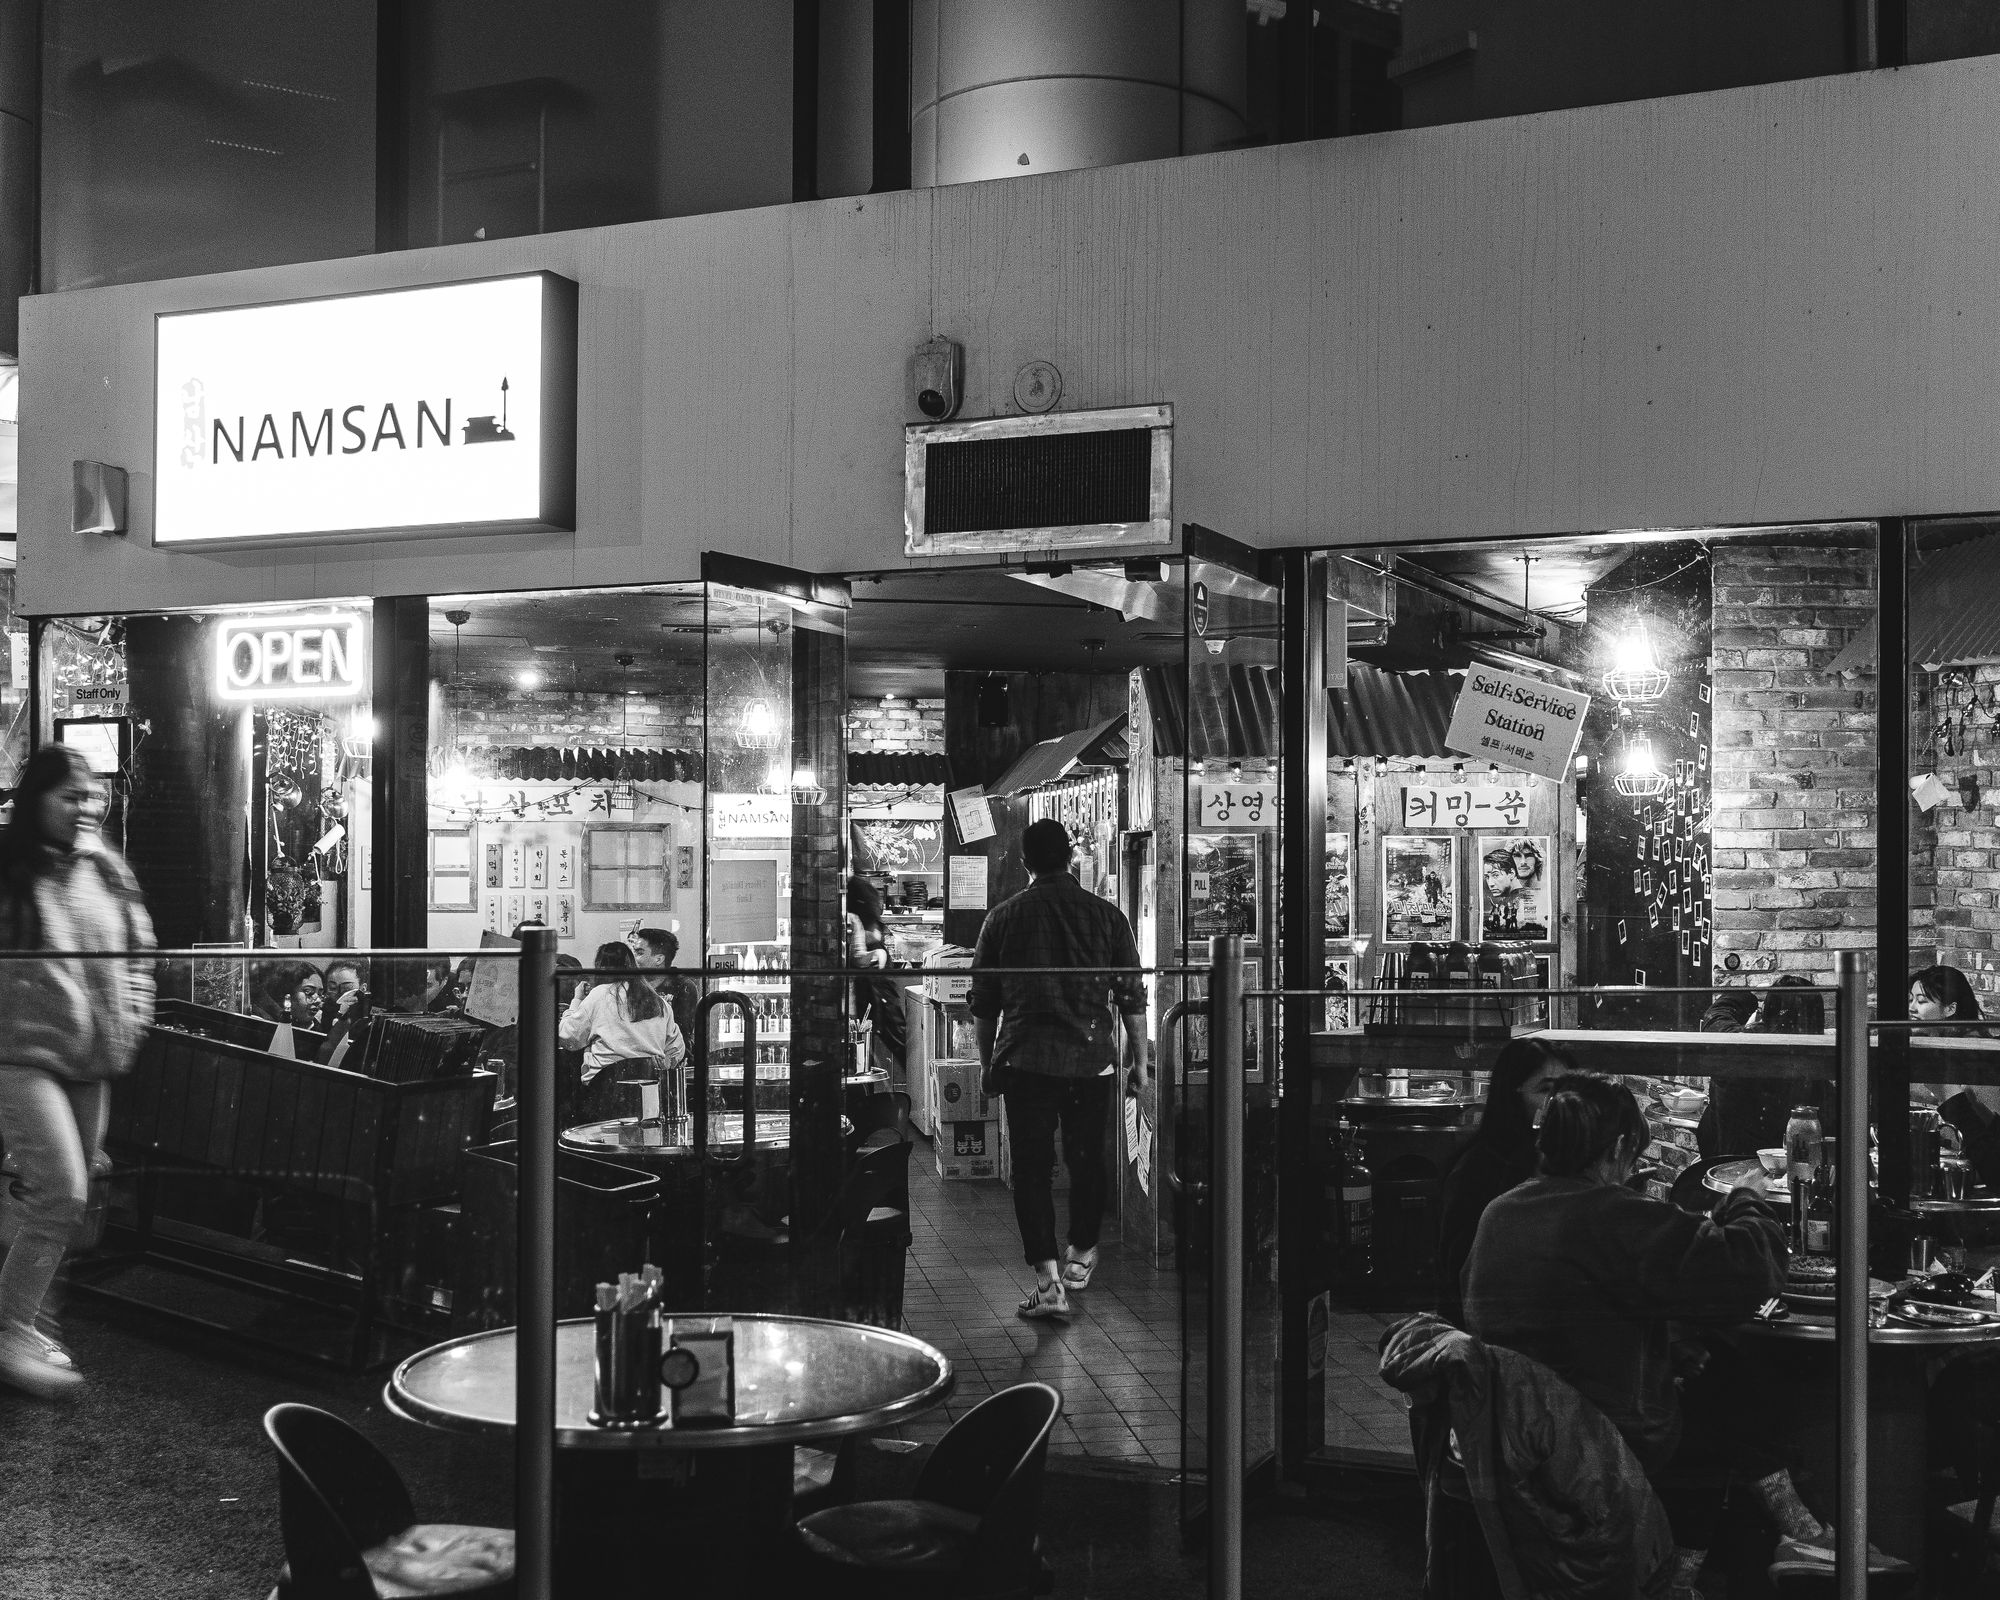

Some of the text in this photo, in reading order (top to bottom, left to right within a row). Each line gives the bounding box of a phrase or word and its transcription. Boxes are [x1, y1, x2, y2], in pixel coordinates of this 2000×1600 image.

[213, 397, 452, 465] NAMSAN
[227, 628, 354, 687] OPEN
[76, 687, 121, 700] Staff Only
[1471, 674, 1577, 721] Self-Service
[1484, 708, 1546, 742] Station
[1480, 735, 1535, 761] 셀프 서비스
[728, 812, 790, 824] NAMSAN
[1409, 790, 1526, 827] 커밍-쑨
[1194, 879, 1207, 891] PULL
[715, 961, 735, 970] PUSH
